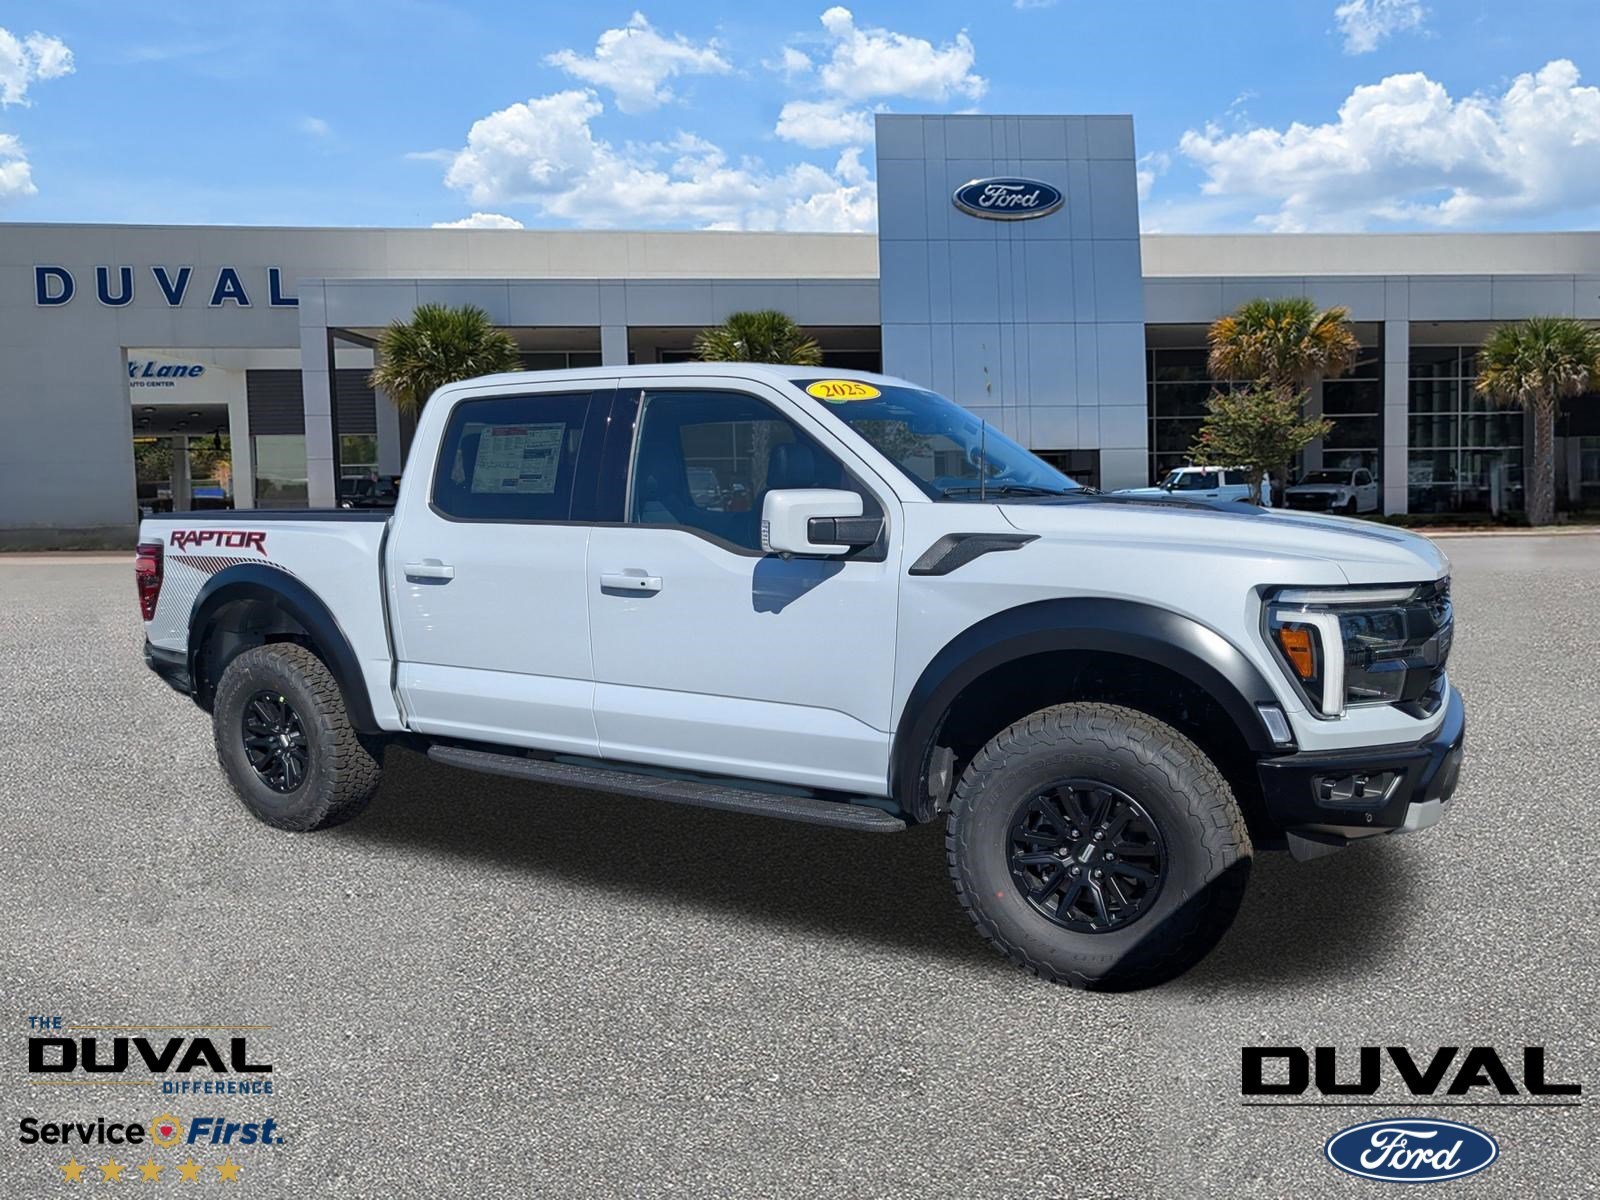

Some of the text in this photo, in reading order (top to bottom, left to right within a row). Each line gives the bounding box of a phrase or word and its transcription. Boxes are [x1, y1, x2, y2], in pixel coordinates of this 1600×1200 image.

[978, 184, 1041, 208] Ford
[33, 265, 299, 308] DUVAL
[142, 361, 205, 378] Lane
[820, 384, 866, 397] 2025
[169, 530, 268, 557] RAPTOR
